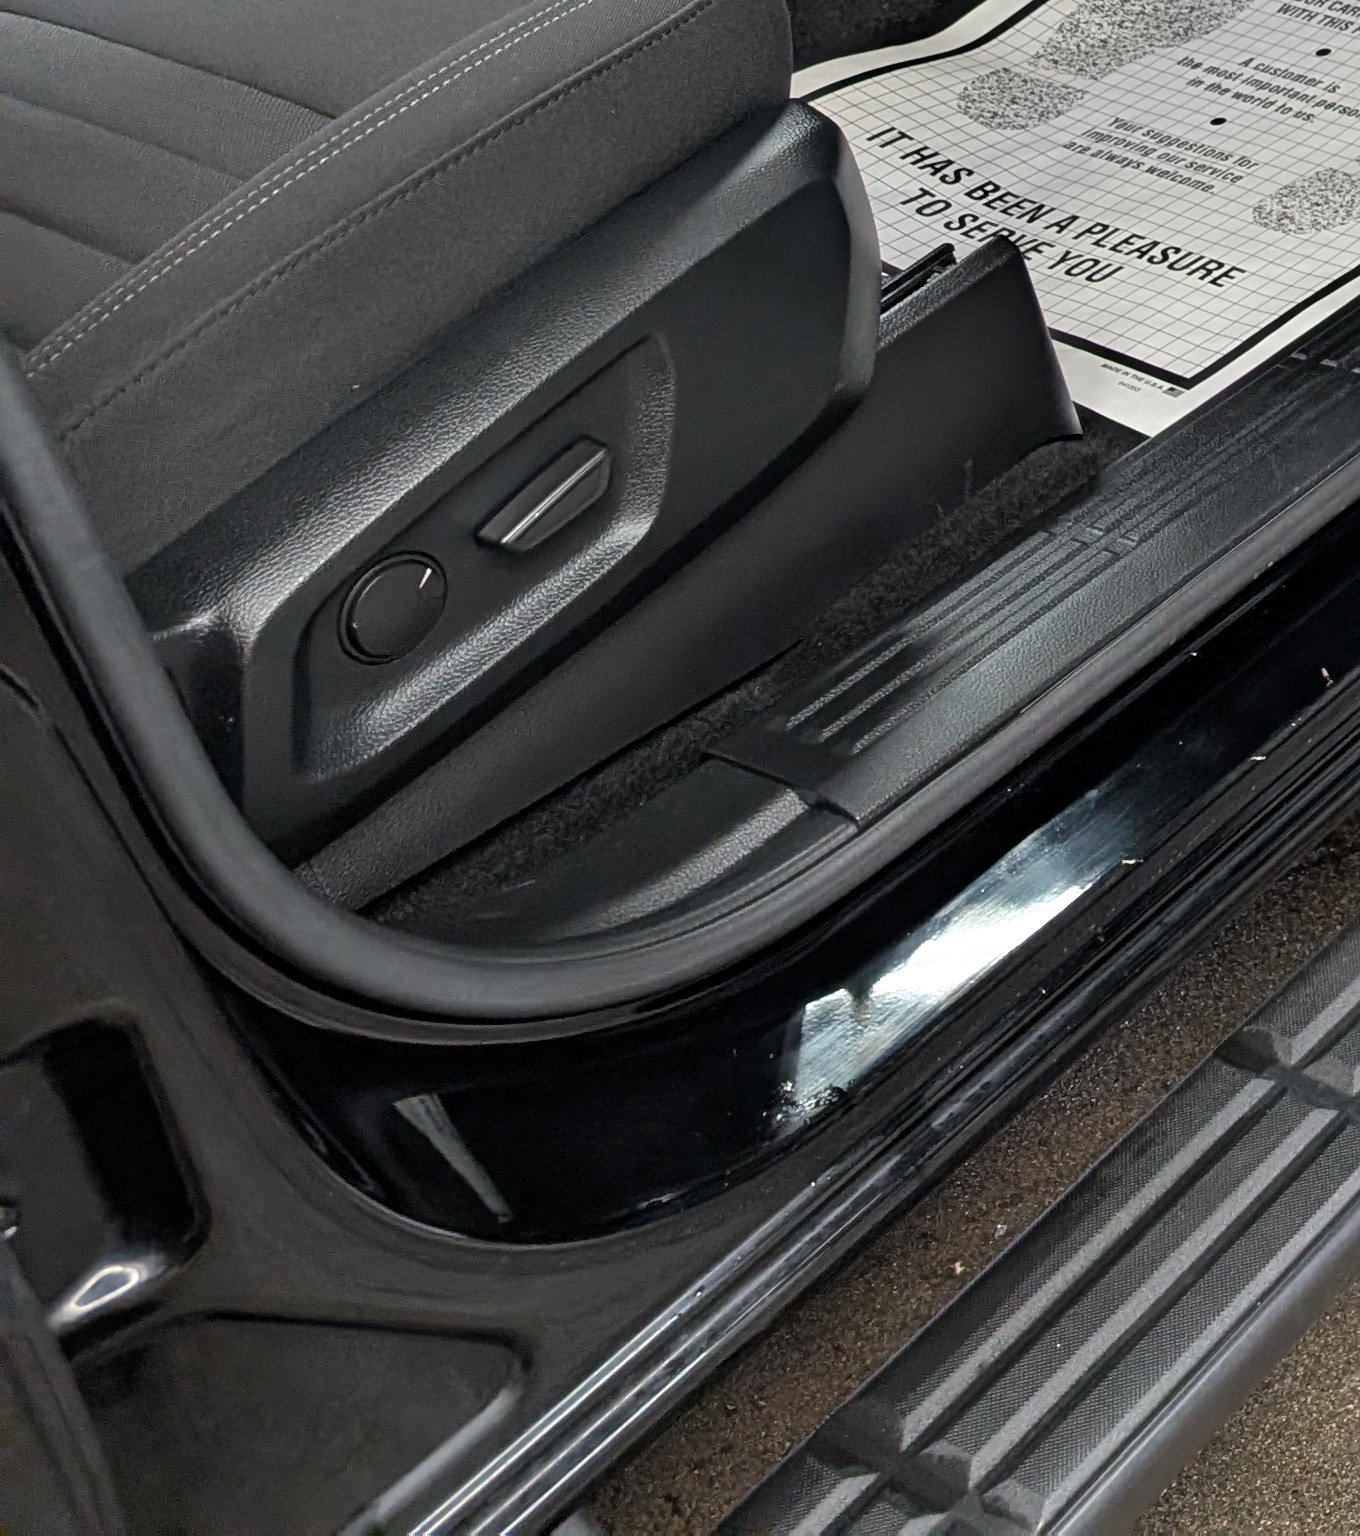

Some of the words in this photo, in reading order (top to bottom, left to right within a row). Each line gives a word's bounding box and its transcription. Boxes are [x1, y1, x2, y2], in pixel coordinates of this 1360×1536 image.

[1277, 3, 1317, 22] WITH
[1317, 13, 1354, 32] THIS
[1177, 56, 1203, 69] the
[1203, 62, 1240, 82] most
[1239, 57, 1255, 67] A
[1250, 61, 1325, 91] customer
[1324, 80, 1341, 94] is
[1186, 76, 1203, 88] in
[1203, 79, 1232, 96] the
[1231, 89, 1276, 110] world
[1274, 101, 1292, 115] to
[1292, 108, 1315, 124] us.
[1107, 117, 1144, 133] Your
[1142, 127, 1237, 163] suggestions
[1231, 153, 1259, 170] for
[1158, 151, 1186, 166] our
[1185, 161, 1245, 184] service
[1062, 141, 1089, 154] are
[1089, 147, 1147, 171] always
[1145, 163, 1215, 195] welcome.
[866, 126, 914, 149] IT
[899, 144, 974, 185] HAS
[963, 180, 1056, 225] BEEN
[1043, 215, 1079, 234] A
[1071, 222, 1247, 289] PLEASURE
[899, 187, 951, 217] TO
[1047, 249, 1124, 284] YOU
